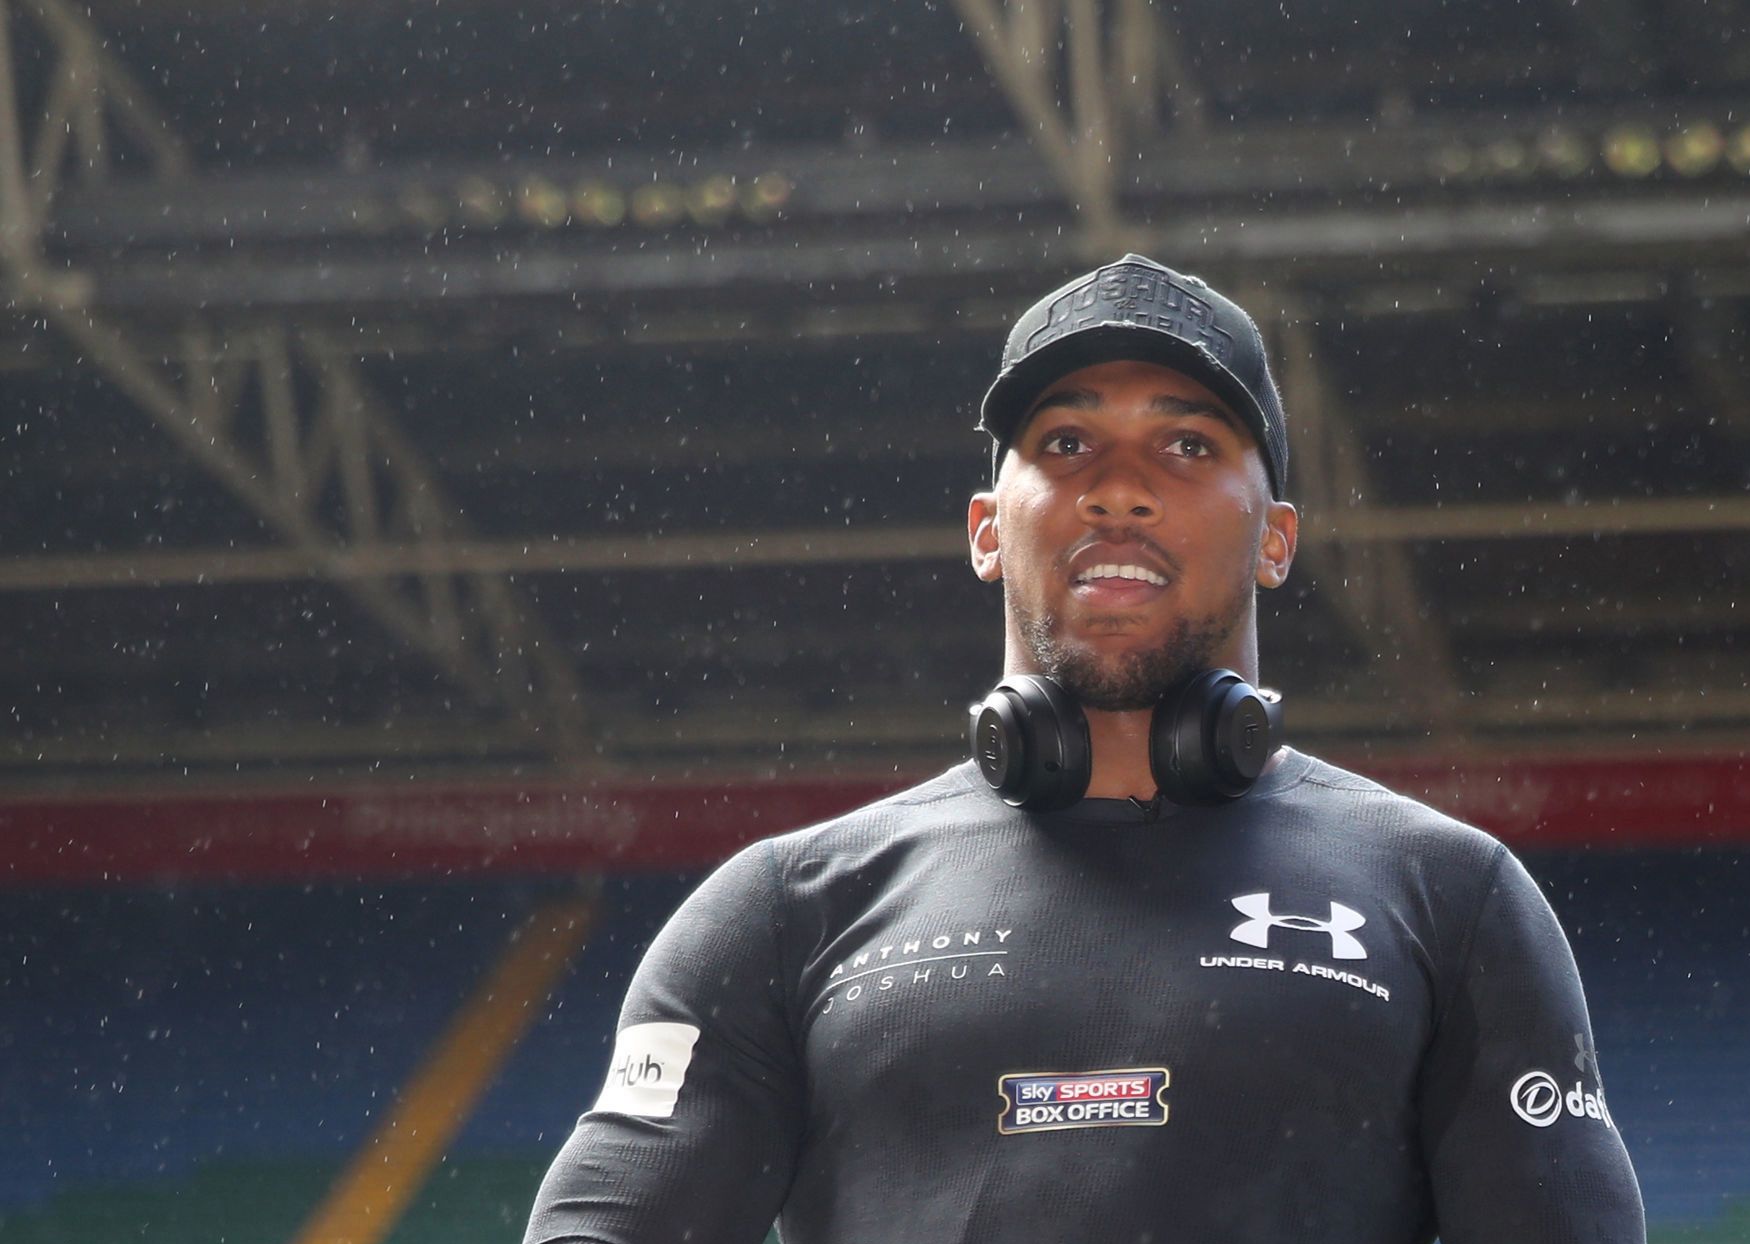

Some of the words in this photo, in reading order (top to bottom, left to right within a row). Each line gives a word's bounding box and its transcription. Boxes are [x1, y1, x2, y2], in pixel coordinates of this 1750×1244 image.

[1051, 275, 1213, 327] JOSHUA
[830, 930, 1011, 978] ANTHONY
[823, 963, 1005, 1014] JOSHUA
[1200, 957, 1284, 971] UNDER
[1292, 963, 1390, 1001] ARMOUR
[1016, 1105, 1064, 1125] BOX
[1068, 1101, 1150, 1120] OFFICE
[1021, 1083, 1053, 1101] sky
[1060, 1080, 1146, 1099] SPORTS
